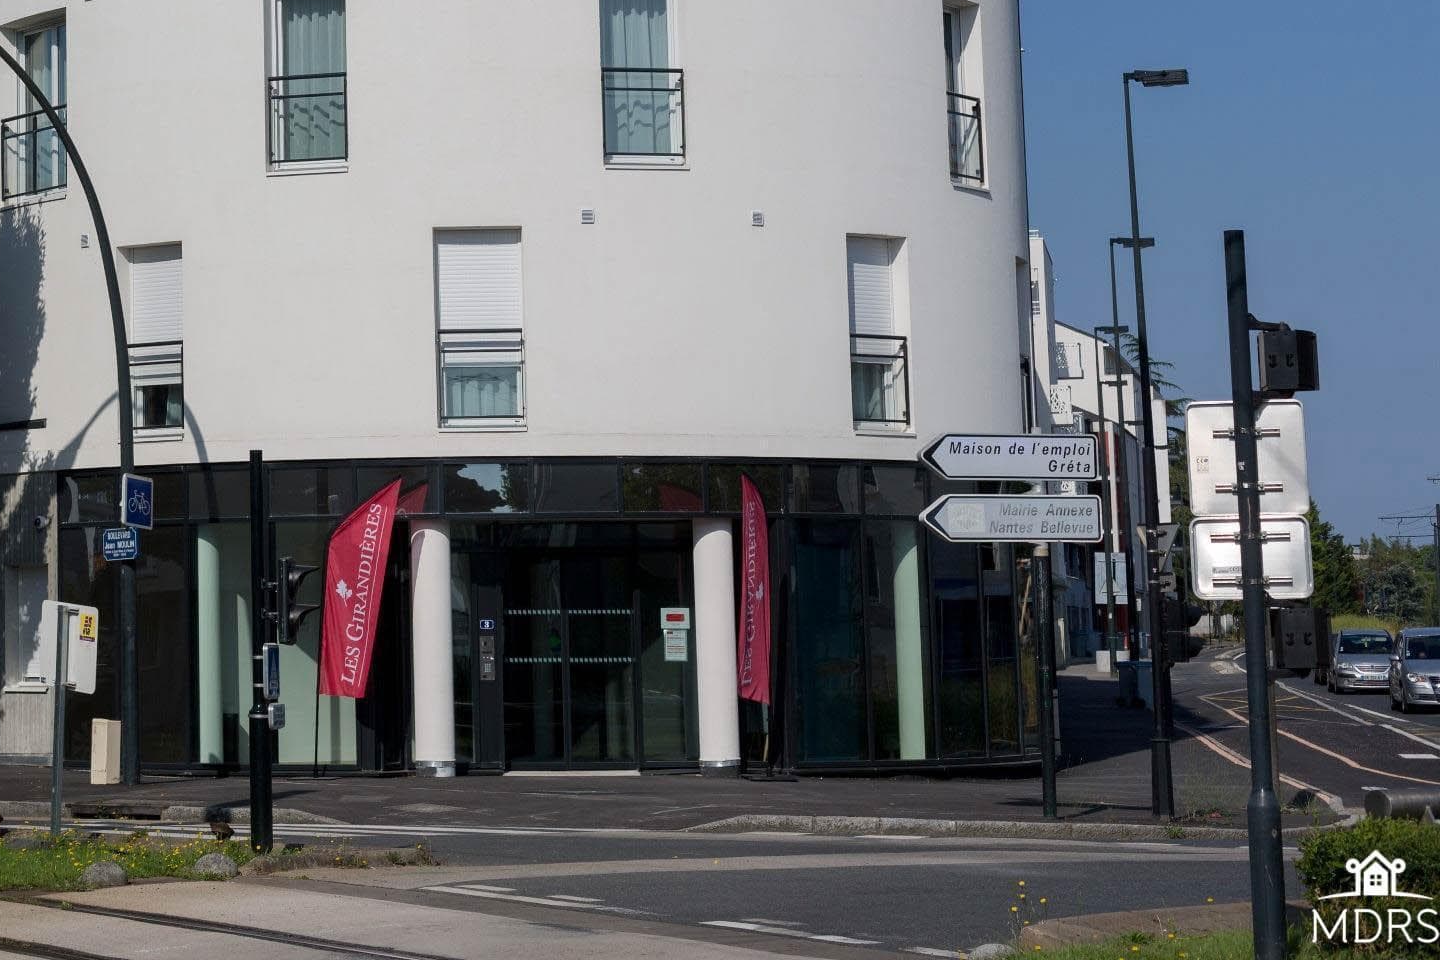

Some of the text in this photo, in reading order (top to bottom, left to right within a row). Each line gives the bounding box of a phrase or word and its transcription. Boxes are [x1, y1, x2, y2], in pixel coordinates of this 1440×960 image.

[949, 441, 1091, 459] Maison de l'emploi
[1048, 459, 1091, 473] Gréta
[999, 503, 1093, 517] Mairie Annexe
[989, 520, 1094, 534] Nantes Bellevue
[116, 539, 135, 549] MOULIN
